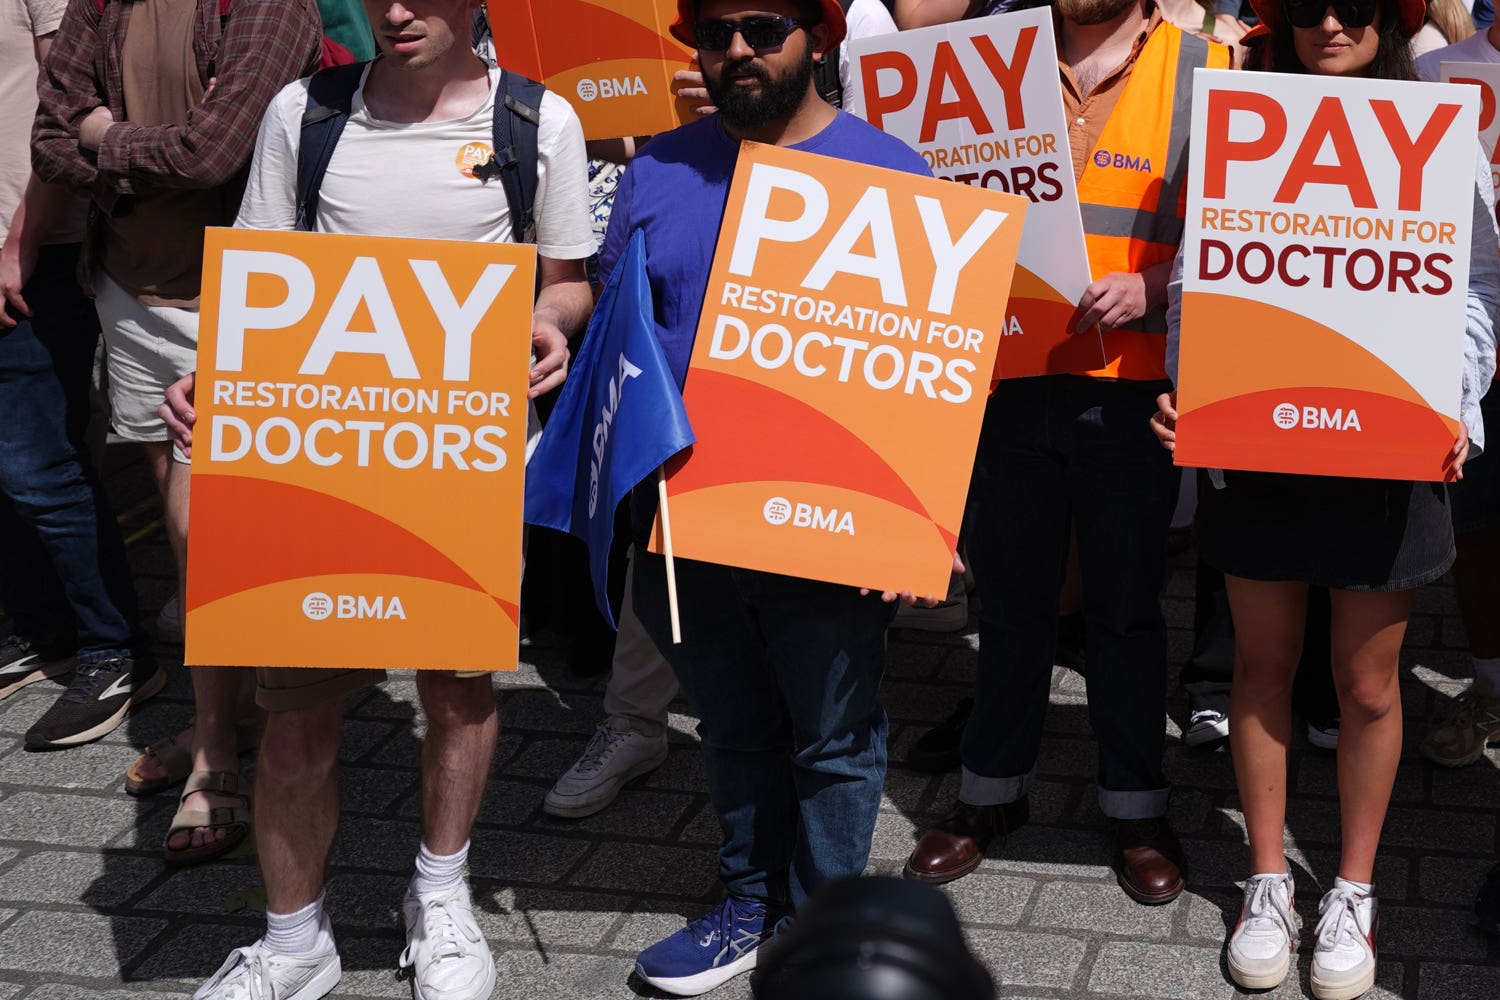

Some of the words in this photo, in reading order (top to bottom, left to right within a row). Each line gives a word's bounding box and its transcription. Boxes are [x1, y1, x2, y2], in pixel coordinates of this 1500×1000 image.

[599, 75, 648, 98] BMA
[860, 25, 1039, 143] PAY
[463, 145, 490, 160] PAY
[920, 139, 1010, 169] ORATION
[1015, 133, 1057, 158] FOR
[1113, 153, 1152, 173] BMA
[1203, 89, 1463, 212] PAY
[728, 162, 1008, 315] PAY
[1201, 207, 1393, 241] RESTORATION
[1401, 220, 1457, 245] FOR
[1199, 239, 1454, 296] DOCTORS
[215, 249, 517, 382] PAY
[721, 282, 921, 341] RESTORATION
[926, 320, 984, 354] FOR
[708, 314, 977, 404] DOCTORS
[213, 381, 438, 415] RESTORATION
[448, 390, 510, 417] FOR
[1302, 406, 1361, 432] BMA
[209, 415, 508, 472] DOCTORS
[793, 503, 855, 536] BMA
[337, 595, 406, 620] BMA
